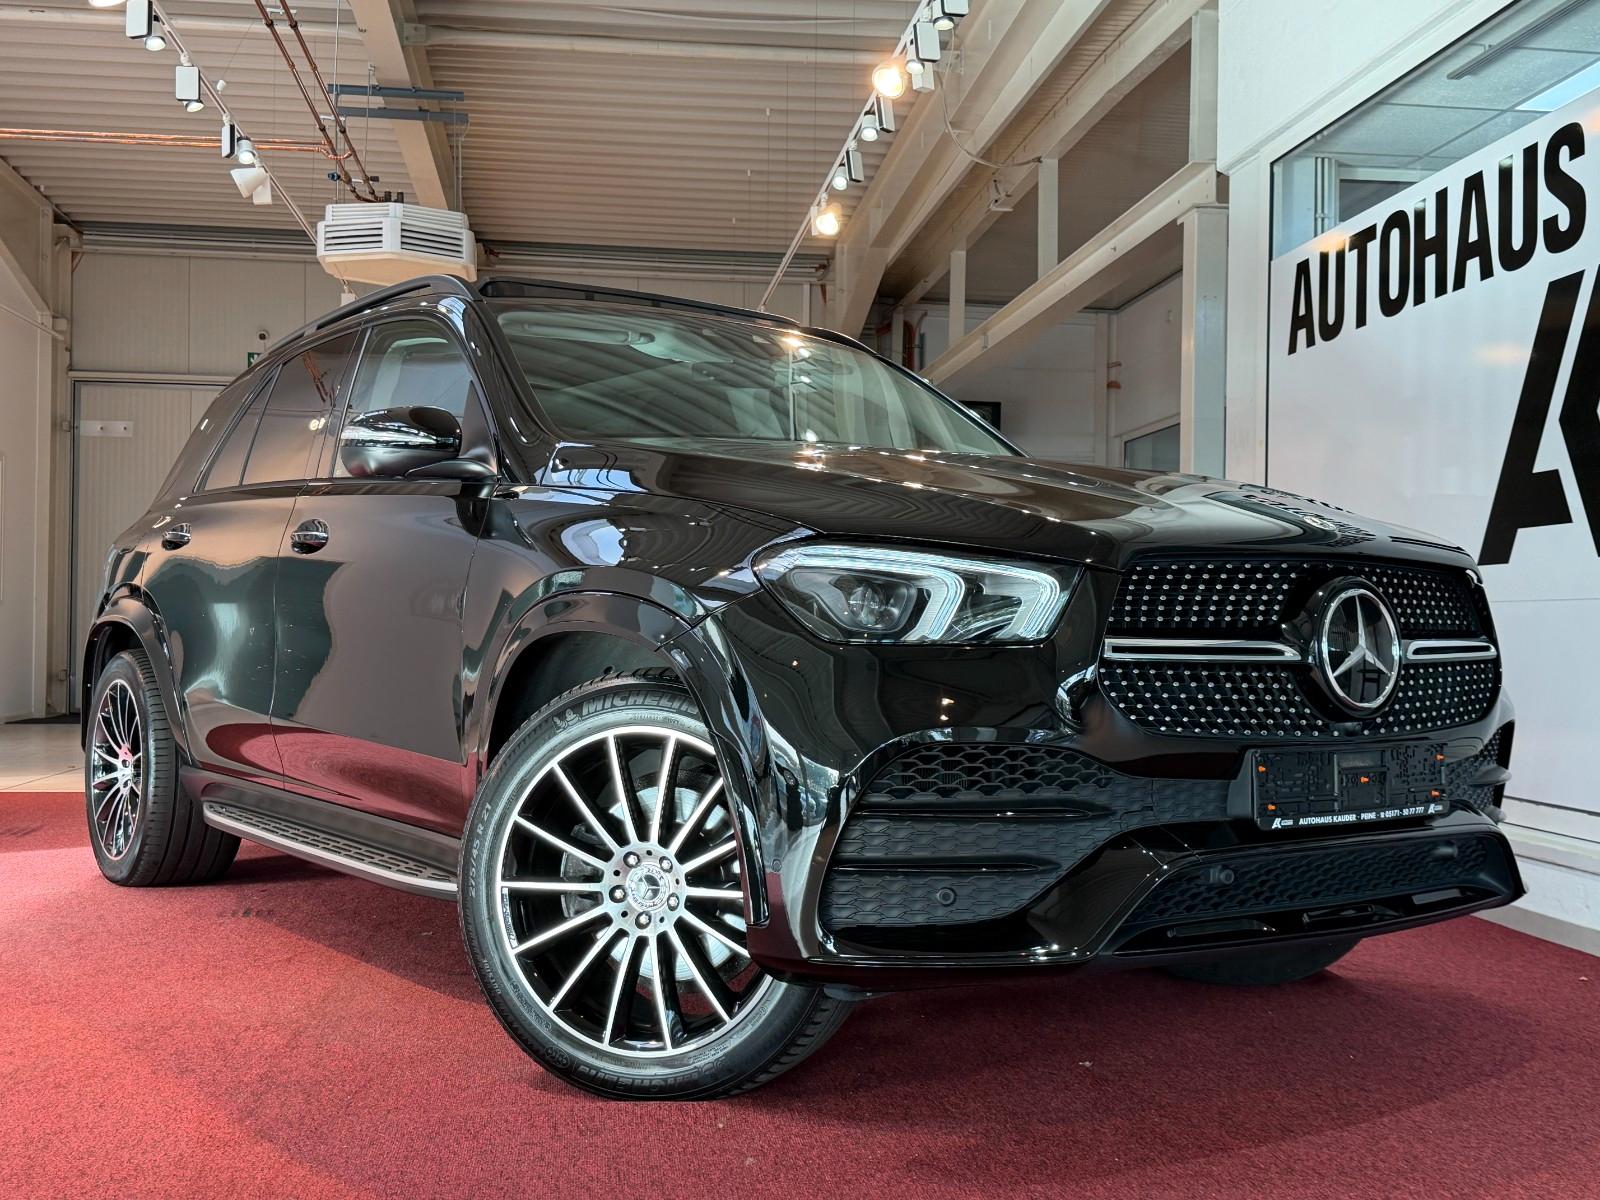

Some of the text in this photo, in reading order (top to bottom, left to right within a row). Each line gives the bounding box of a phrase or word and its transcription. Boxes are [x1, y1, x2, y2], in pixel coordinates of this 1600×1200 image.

[1288, 122, 1586, 356] AUTOHAUS
[582, 690, 699, 716] MICHELIN
[1298, 815, 1333, 825] AUTOHAUS
[1333, 813, 1357, 823] KAUDER
[1360, 811, 1377, 820] PEINE
[469, 802, 491, 898] 275/45 R 21
